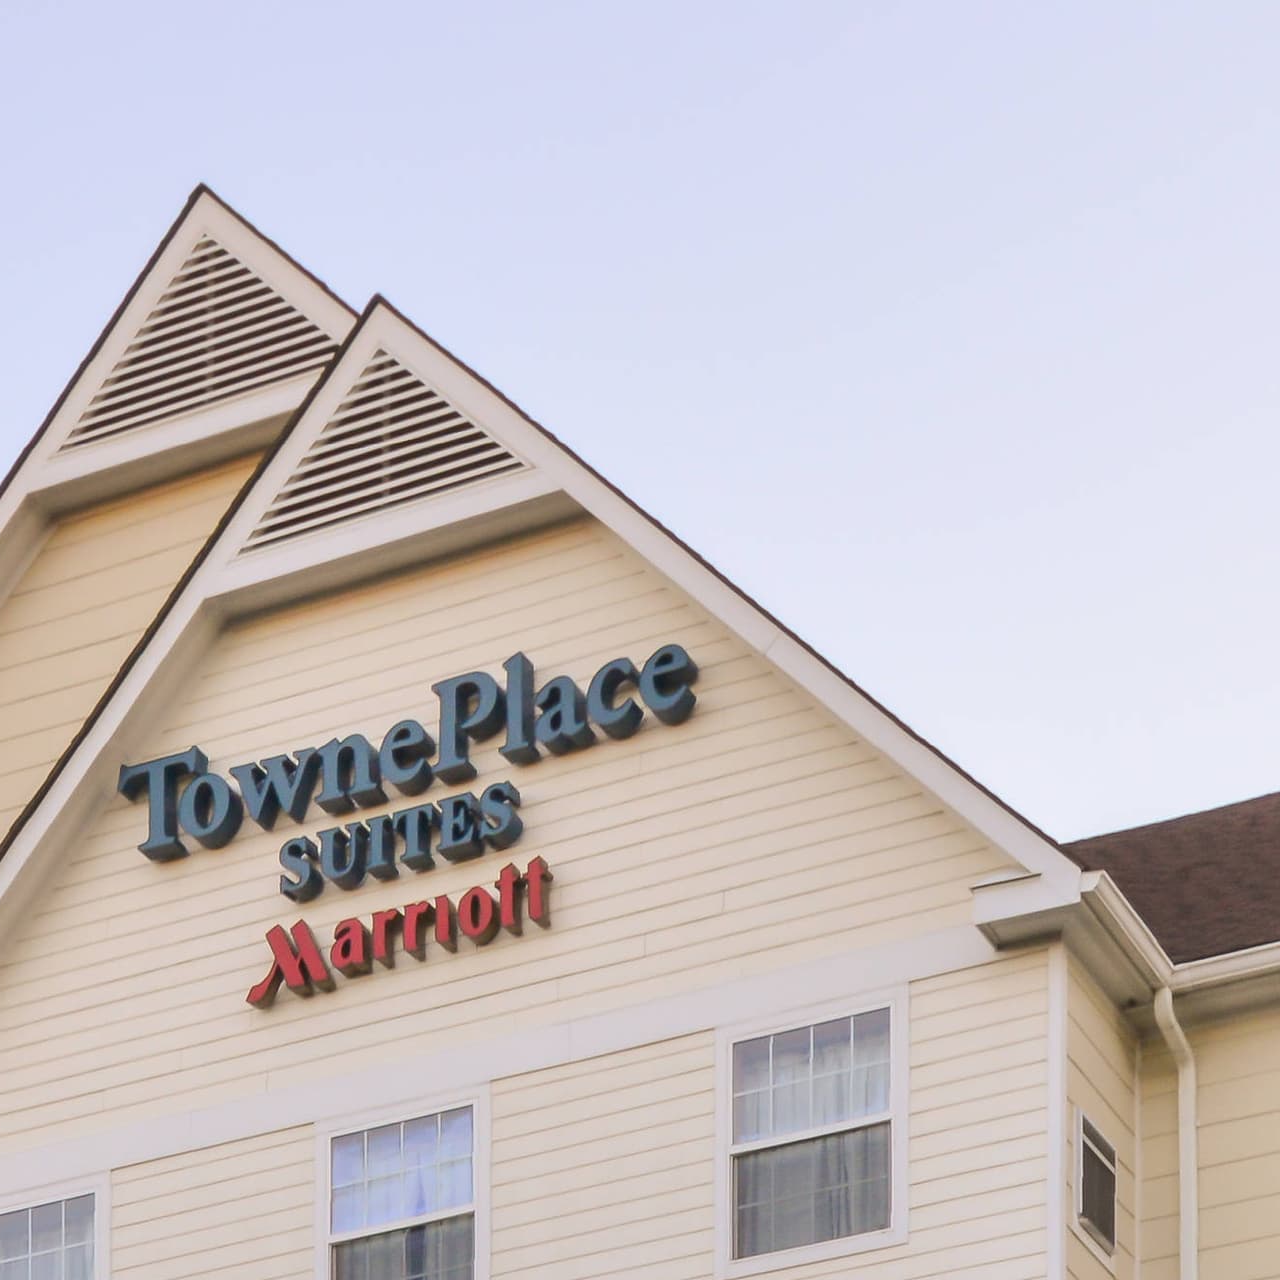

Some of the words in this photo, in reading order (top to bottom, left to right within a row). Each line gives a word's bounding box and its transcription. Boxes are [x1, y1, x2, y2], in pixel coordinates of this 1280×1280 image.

[119, 643, 699, 862] TownePlace
[279, 780, 524, 903] SUITES
[246, 855, 553, 1009] Marriott
